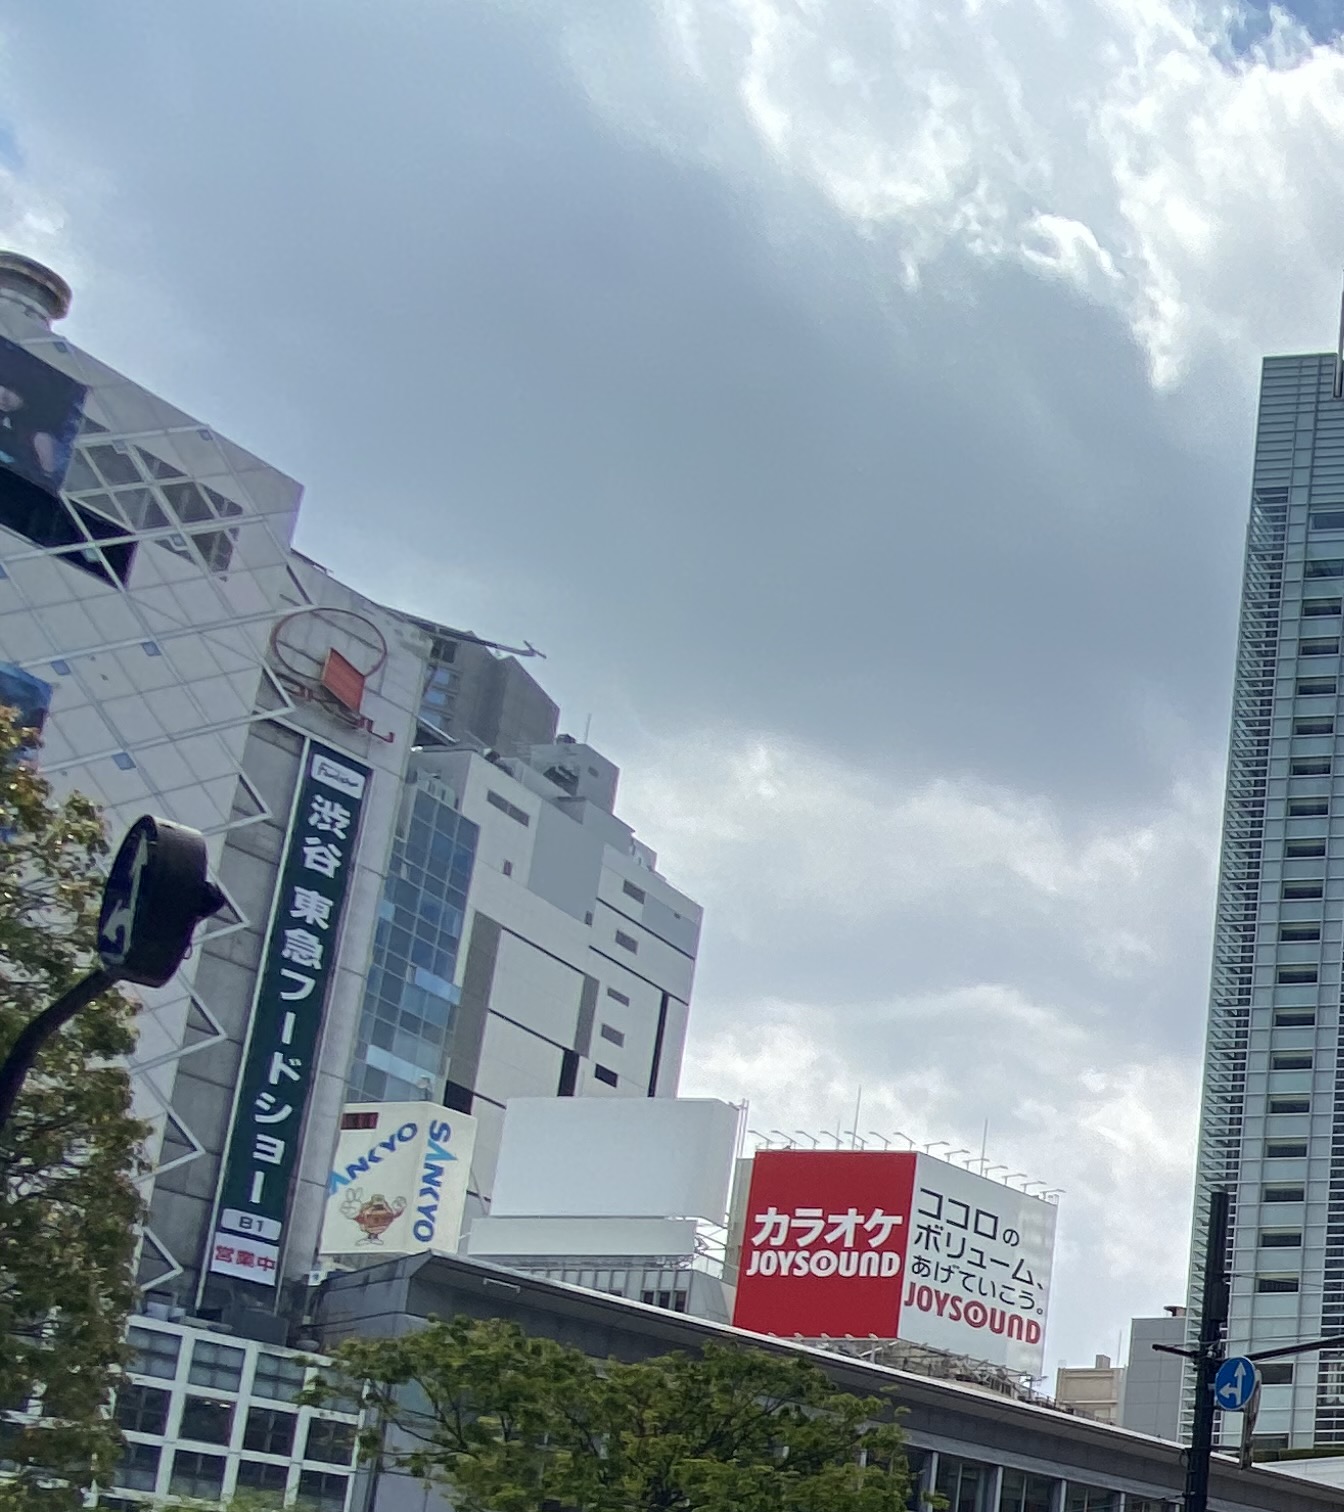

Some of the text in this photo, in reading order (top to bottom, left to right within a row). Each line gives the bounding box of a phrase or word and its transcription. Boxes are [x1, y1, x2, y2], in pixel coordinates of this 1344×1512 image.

[239, 1216, 265, 1231] B1
[752, 1207, 903, 1248] カラオケ
[919, 1187, 1020, 1247] ココロの
[215, 1244, 275, 1272] 営業中
[746, 1249, 900, 1278] JOYSOUND
[915, 1223, 1044, 1290] ボリューム、
[911, 1255, 1043, 1315] あげていこう。
[904, 1282, 1041, 1344] JOYSOUND
